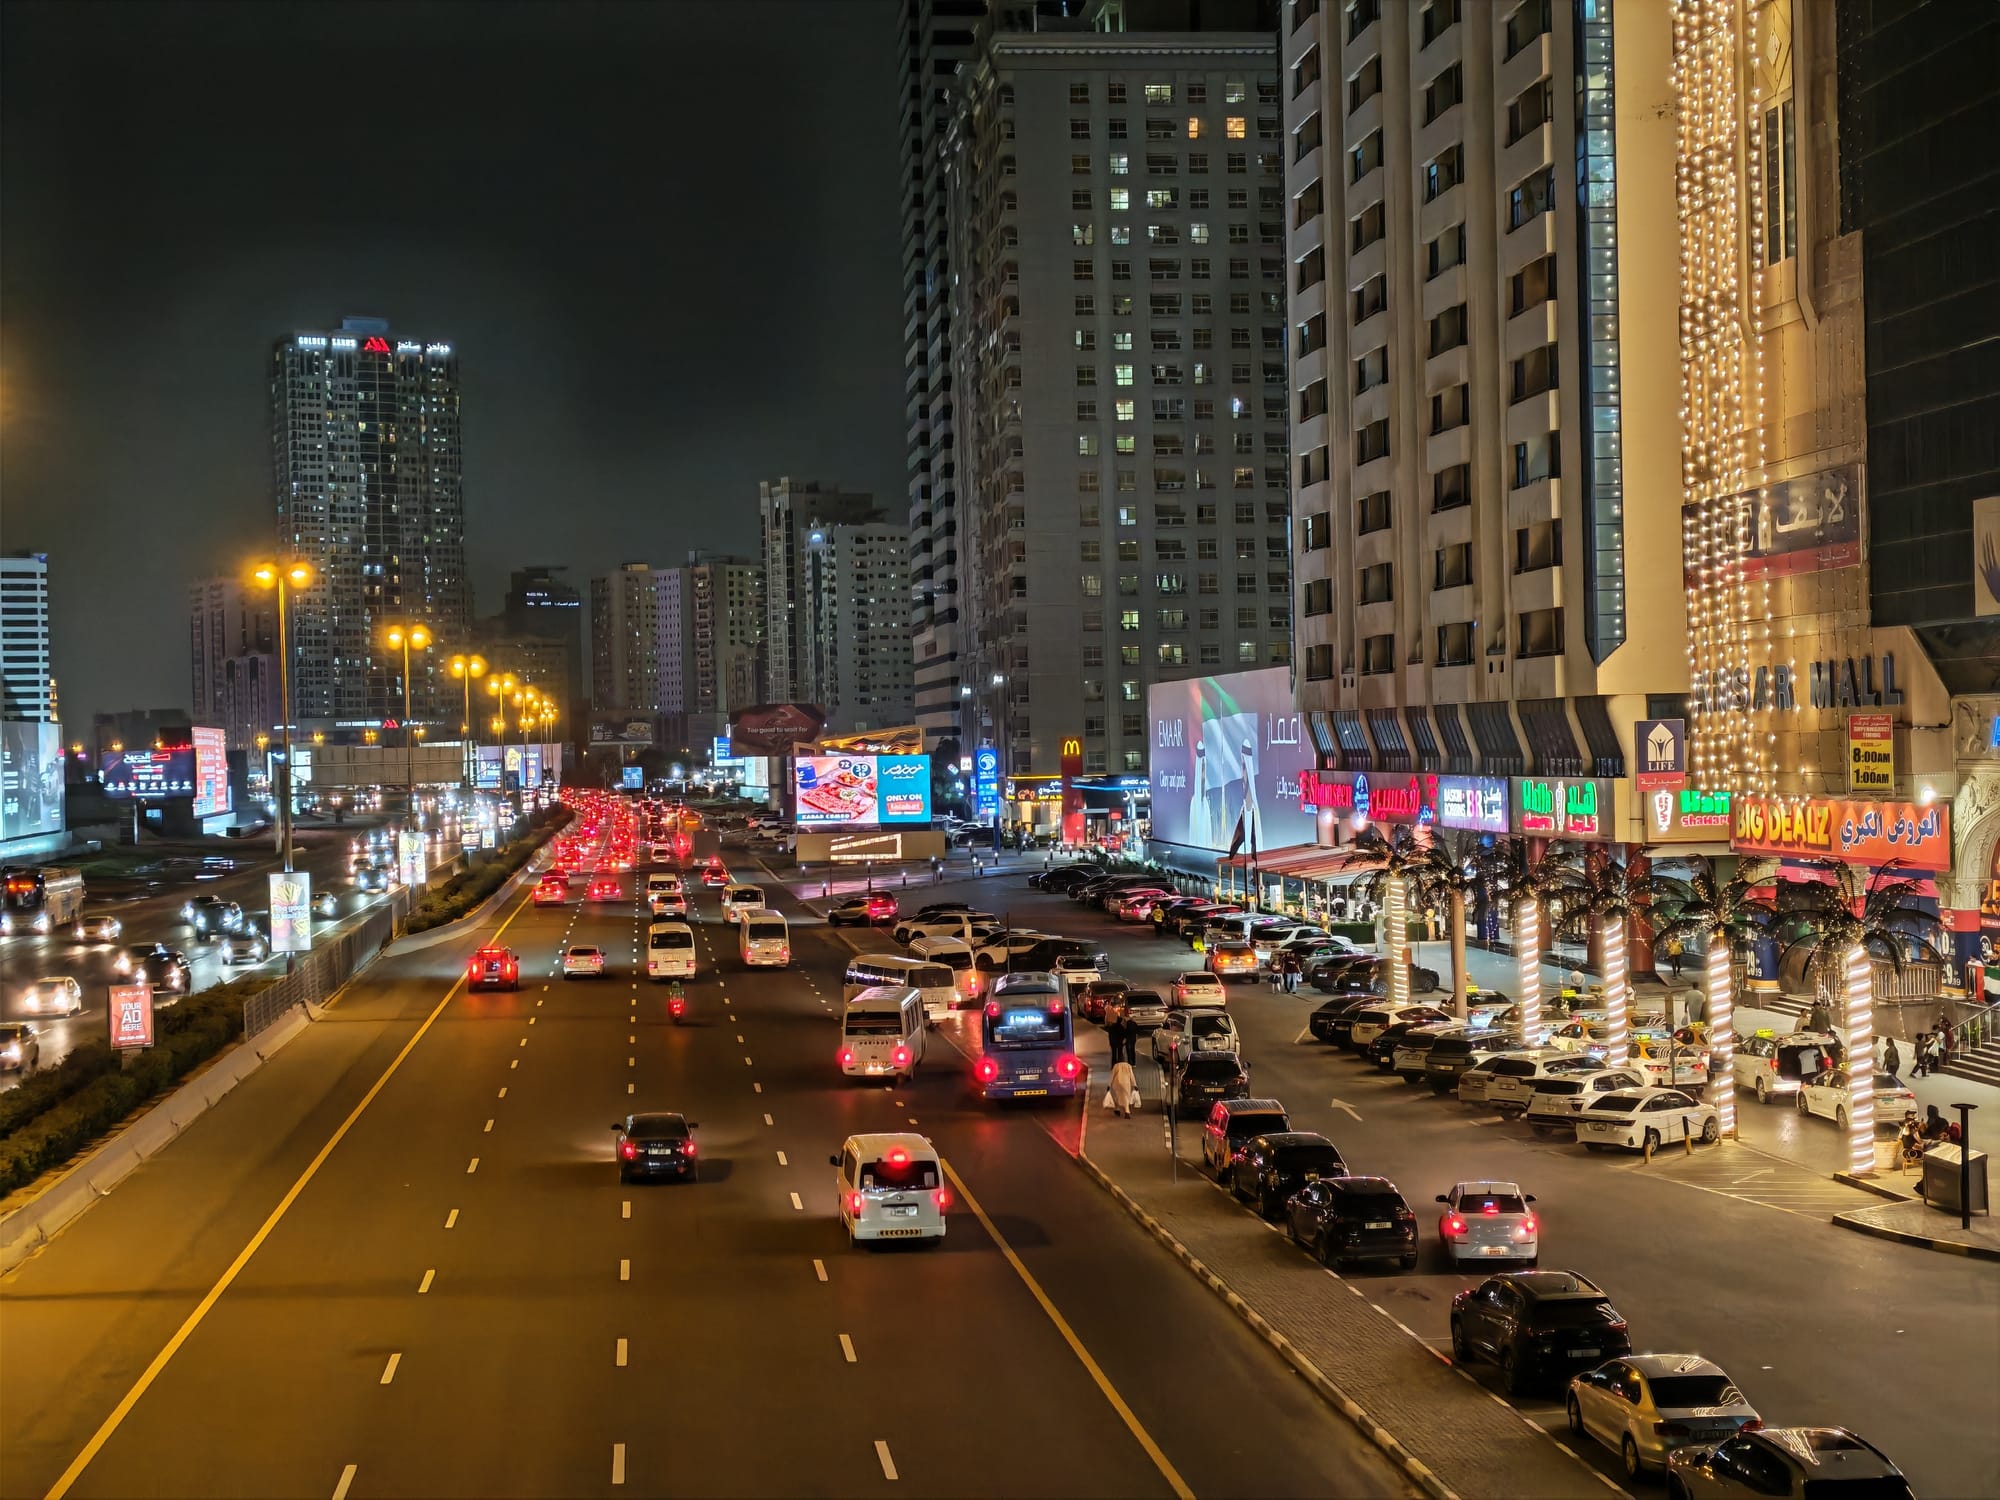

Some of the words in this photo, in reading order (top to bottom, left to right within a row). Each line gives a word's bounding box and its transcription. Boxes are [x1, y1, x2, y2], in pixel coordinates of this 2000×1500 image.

[1696, 664, 1795, 713] ANSAR
[1808, 653, 1904, 709] MALL
[1159, 718, 1184, 748] EMAAR
[1266, 712, 1302, 753] إعمار
[1853, 747, 1890, 763] 8:00AM
[1648, 761, 1675, 772] LIFE
[1640, 778, 1683, 787] صيدلية
[1854, 768, 1889, 784] 1:00AM
[885, 794, 908, 802] ONLY
[908, 793, 923, 801] ON
[1735, 803, 1764, 841] BIG
[1768, 803, 1831, 846] DEALZ
[1886, 808, 1941, 846] العروض
[120, 1001, 142, 1011] YOUR
[122, 1010, 142, 1024] AD
[121, 1023, 143, 1032] HERE
